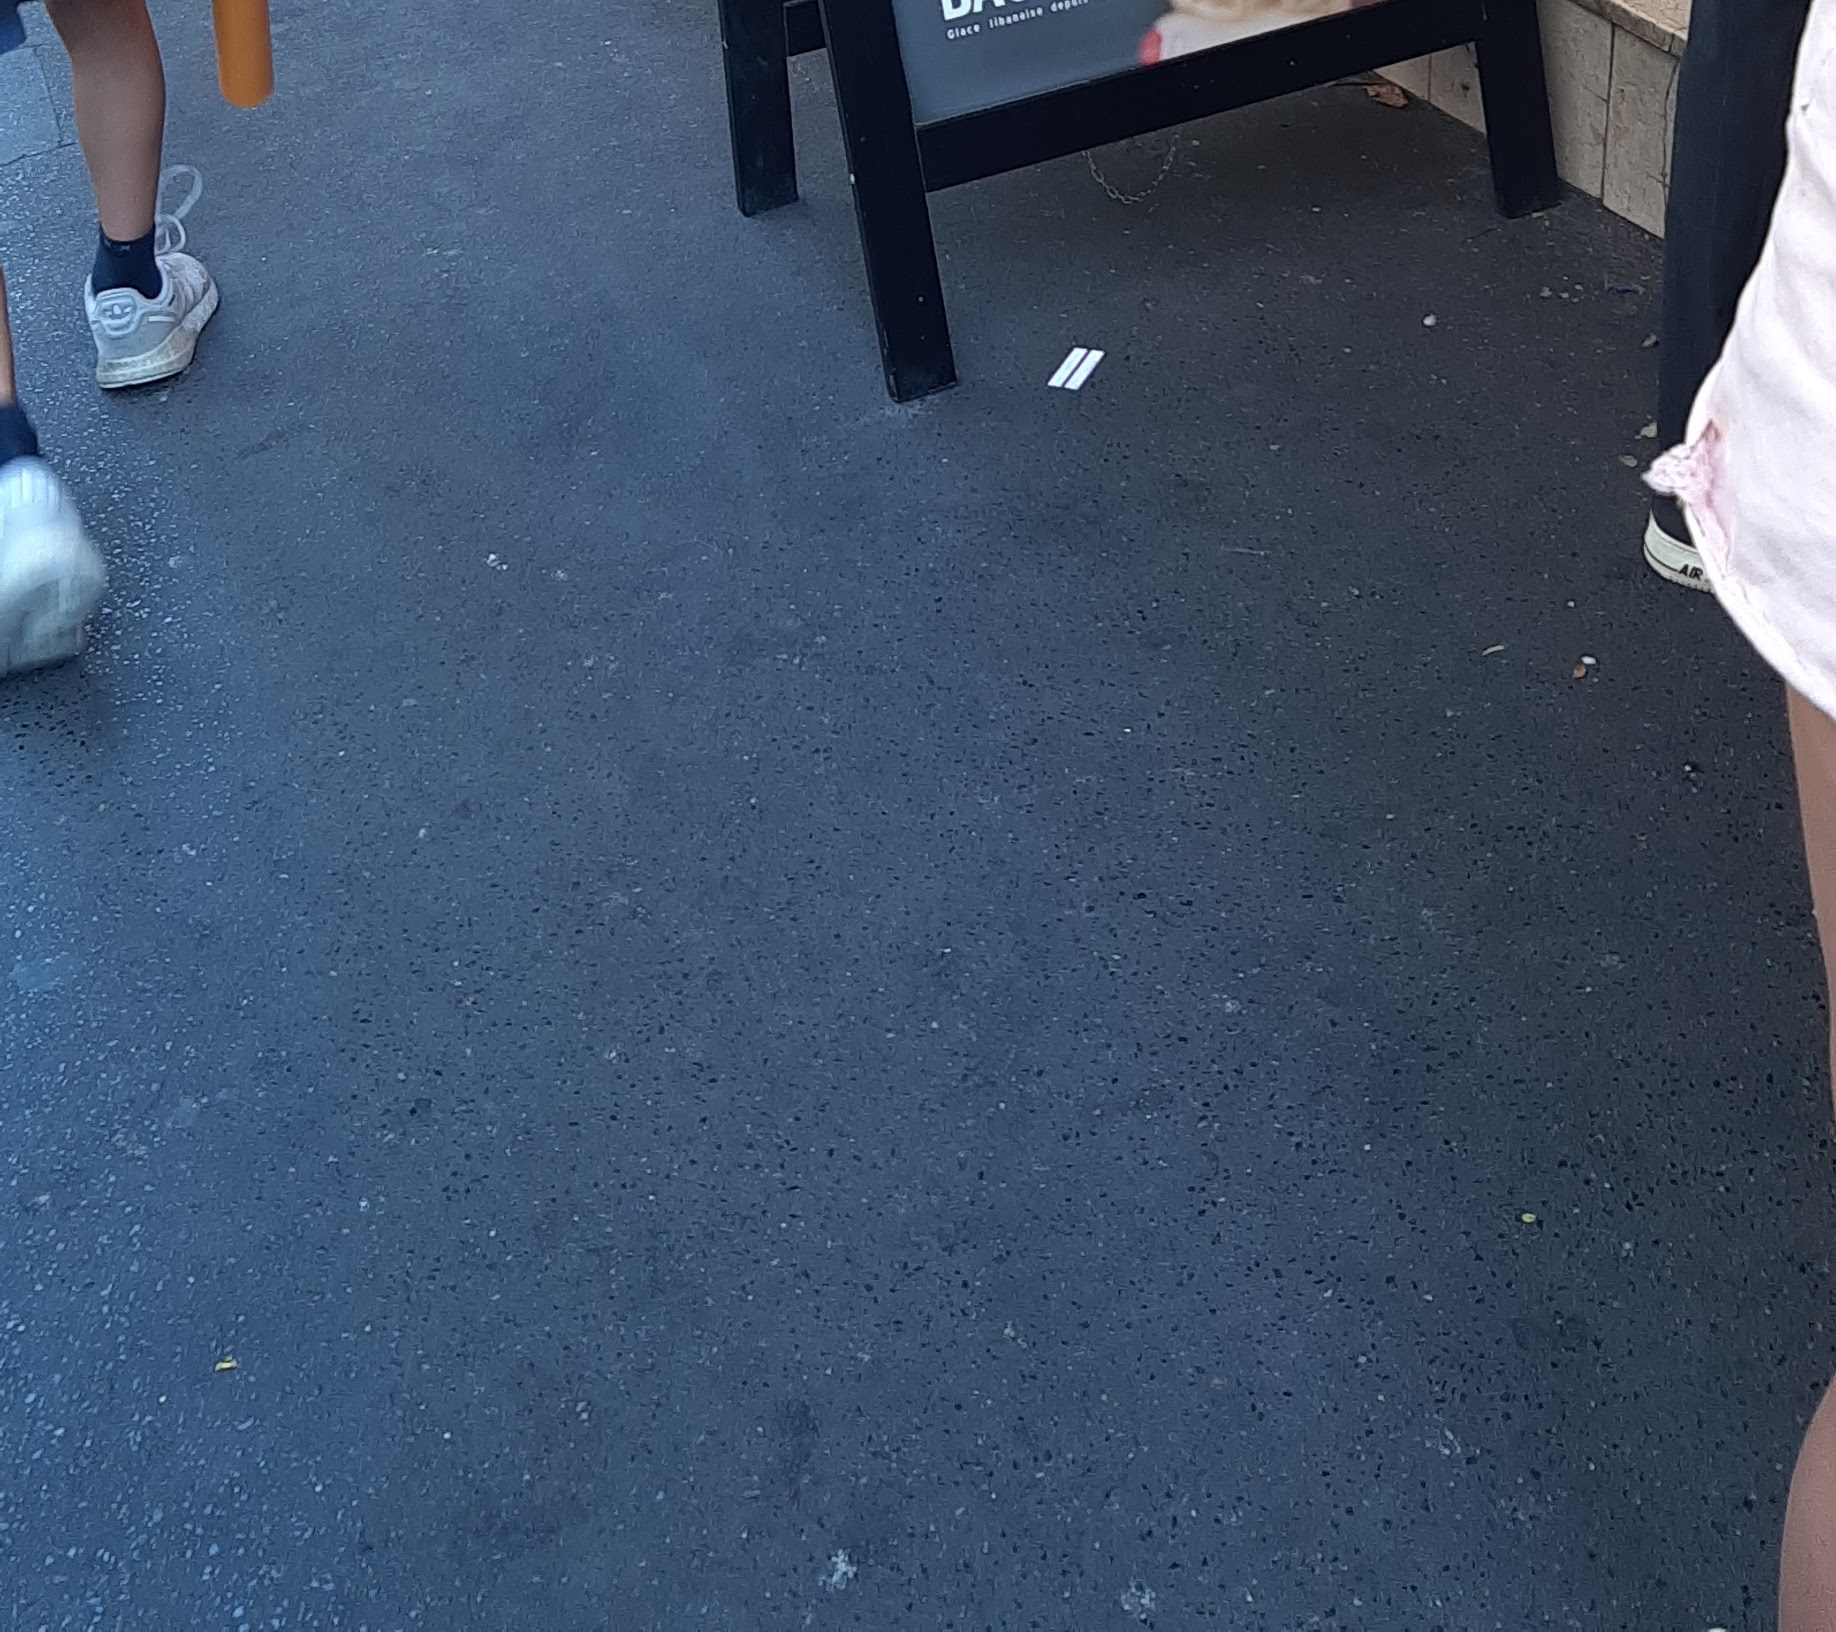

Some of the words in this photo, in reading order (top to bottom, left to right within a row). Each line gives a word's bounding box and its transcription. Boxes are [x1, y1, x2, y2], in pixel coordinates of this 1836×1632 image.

[946, 23, 981, 40] Glace
[989, 6, 1044, 29] libanaise
[1678, 563, 1704, 581] AIR
